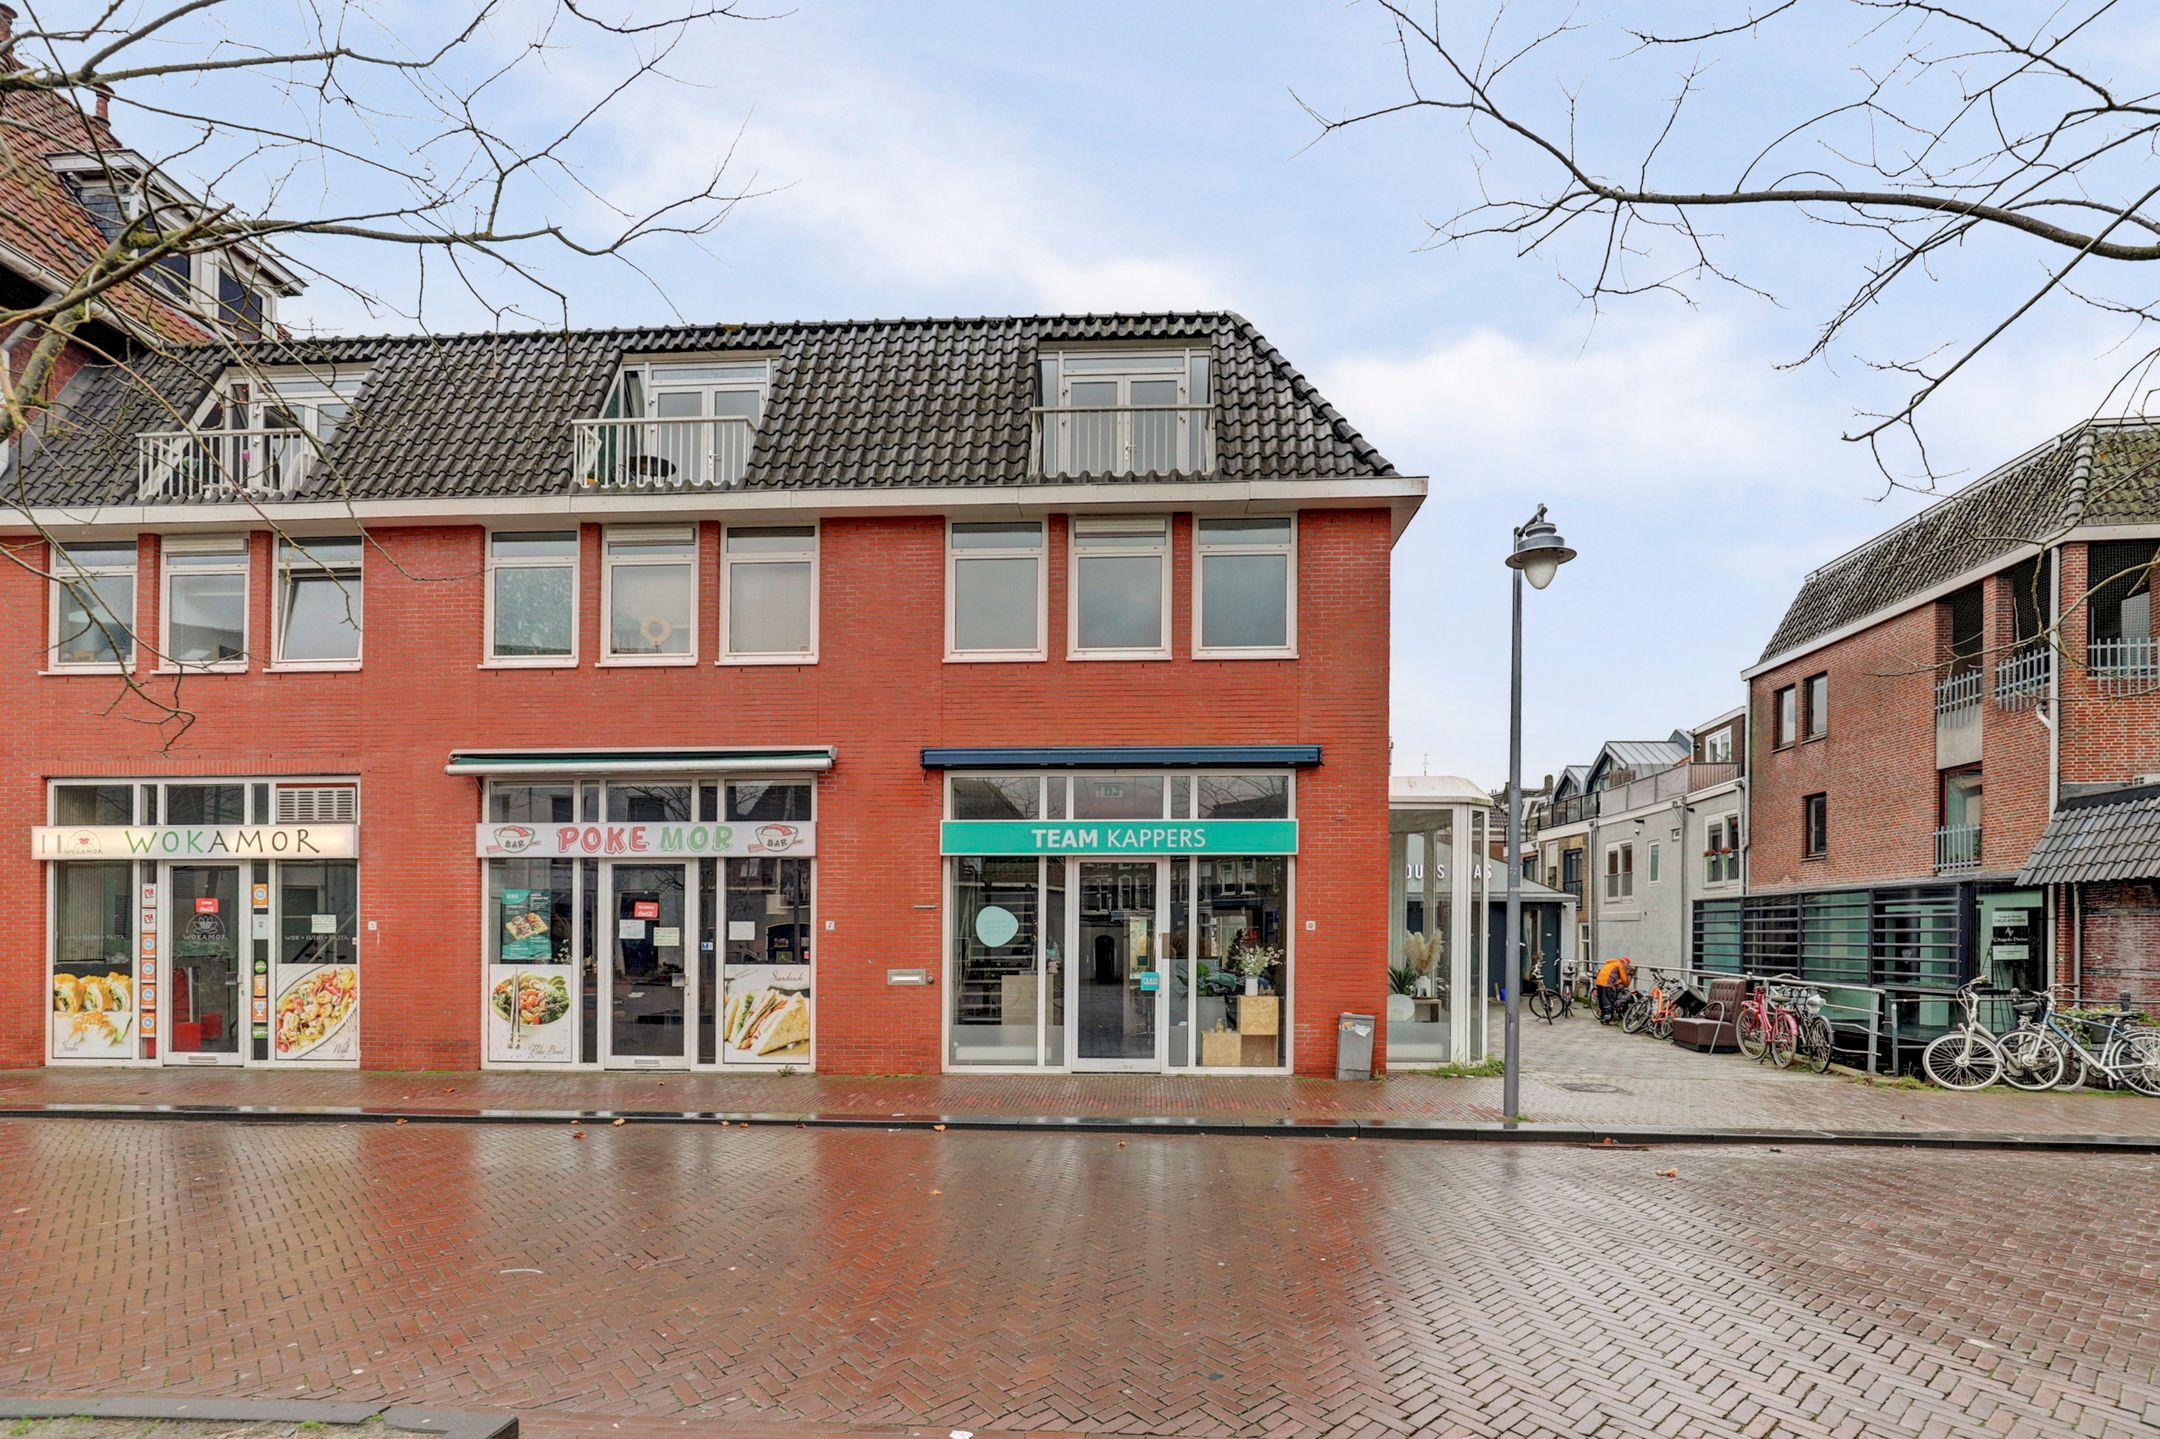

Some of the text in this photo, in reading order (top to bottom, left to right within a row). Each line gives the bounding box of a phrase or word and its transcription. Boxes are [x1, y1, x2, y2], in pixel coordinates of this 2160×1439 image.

[124, 828, 321, 854] WOKAMOR
[504, 838, 526, 849] BAR
[556, 825, 735, 855] POKE MOR
[766, 838, 789, 849] BAR
[1031, 828, 1206, 848] TEAM KAPPERS
[182, 933, 229, 941] WOKAMOR
